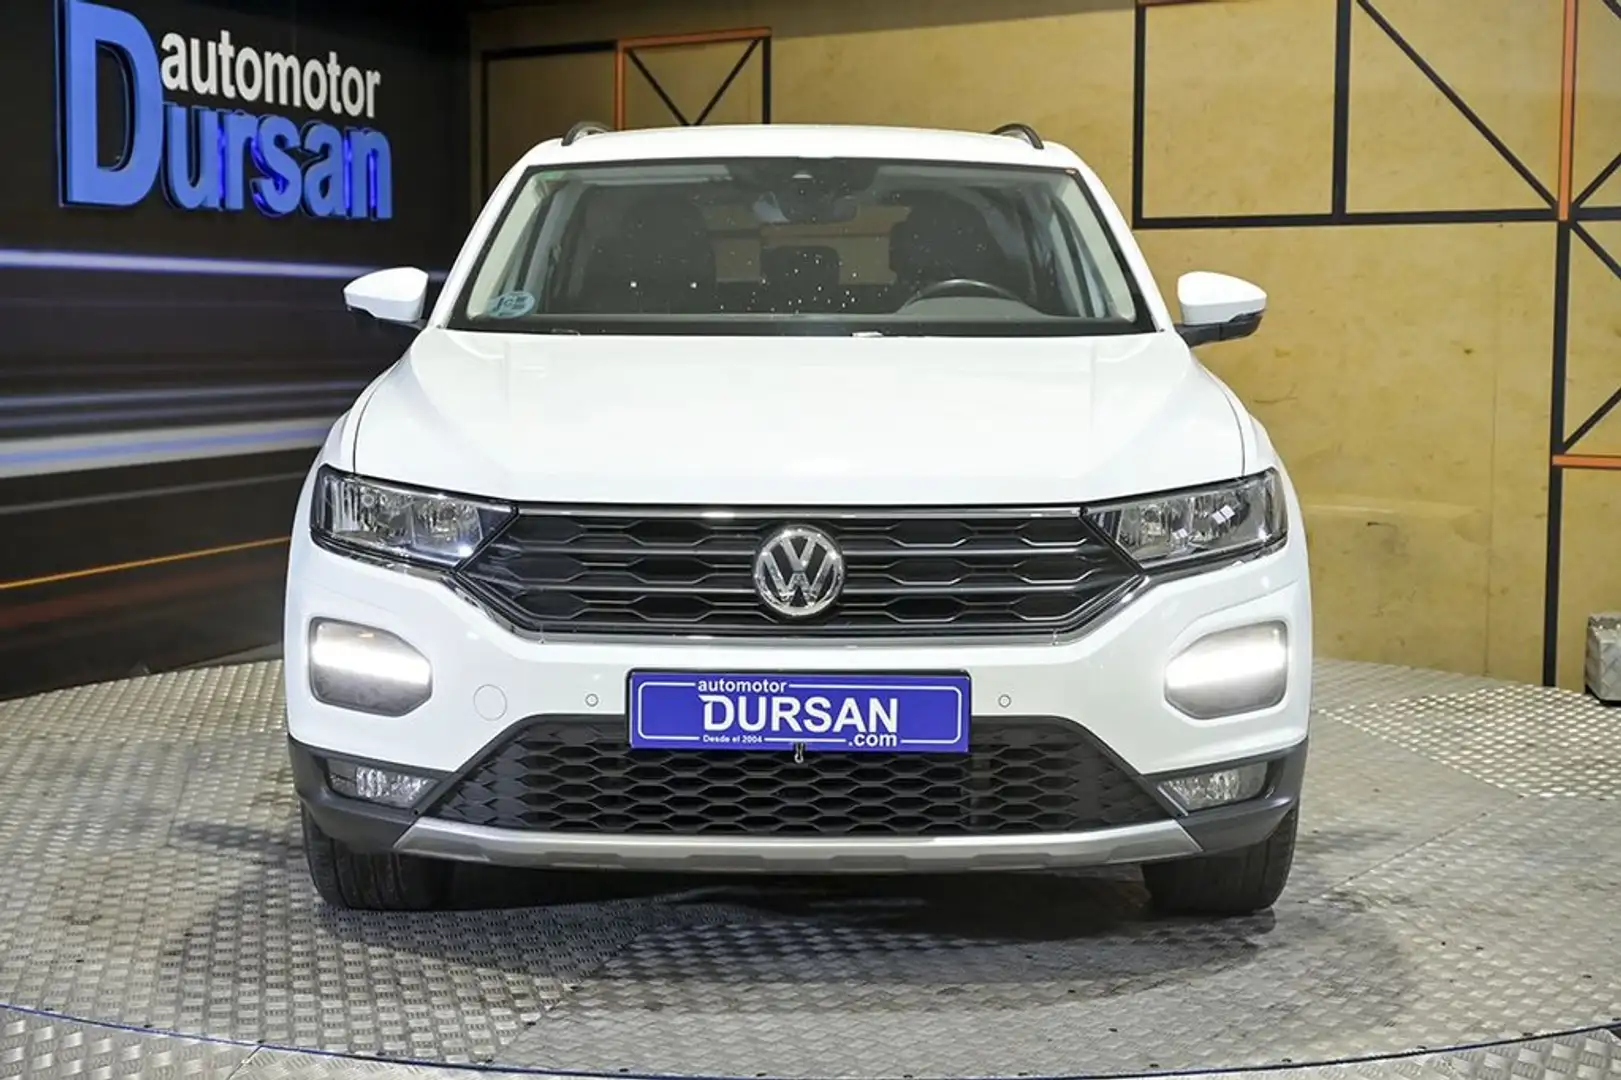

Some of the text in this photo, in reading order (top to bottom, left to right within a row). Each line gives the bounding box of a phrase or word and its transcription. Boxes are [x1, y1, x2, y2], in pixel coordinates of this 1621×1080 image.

[160, 30, 381, 118] automotor
[57, 0, 392, 219] Dursan
[698, 679, 787, 693] automotor
[699, 695, 898, 733] DURSAN
[703, 735, 762, 743] Desde el 2004
[849, 733, 898, 747] .com
